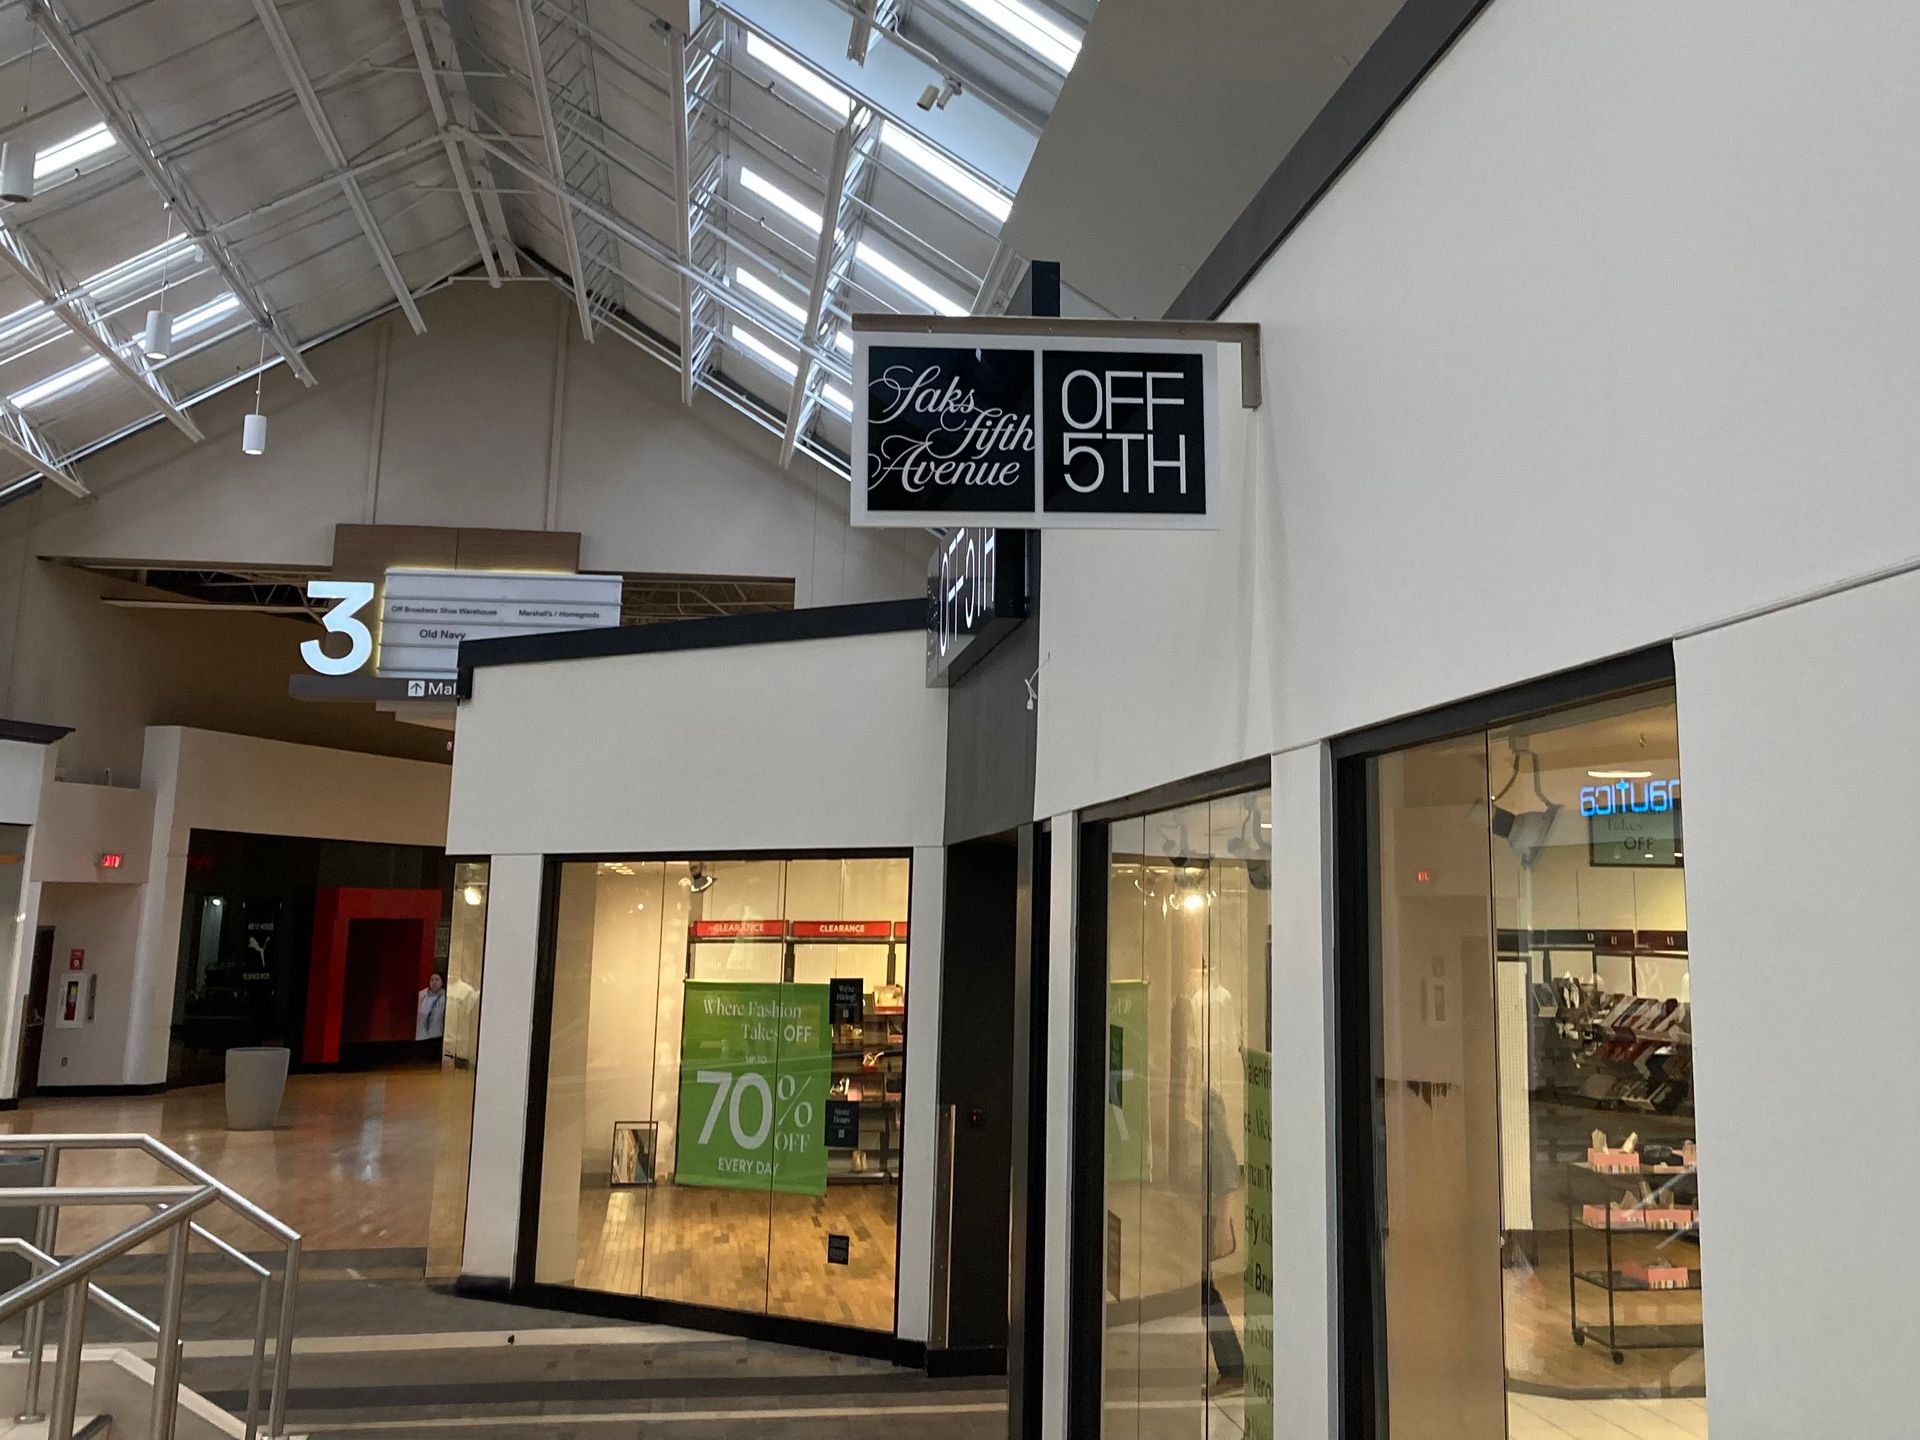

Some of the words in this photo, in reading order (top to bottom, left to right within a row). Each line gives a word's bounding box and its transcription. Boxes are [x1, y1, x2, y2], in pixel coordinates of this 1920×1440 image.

[868, 364, 977, 424] Saks
[1062, 369, 1185, 431] OFF
[926, 407, 1036, 460] Fifth
[868, 434, 1020, 493] Avenue
[1063, 432, 1187, 494] 5TH
[391, 605, 403, 613] Off
[404, 606, 438, 615] Broadway
[440, 607, 457, 615] Shoe
[459, 608, 498, 616] Warehouse
[558, 611, 600, 620] Homegoods
[300, 580, 375, 676] 3
[419, 629, 438, 639] Old
[440, 630, 466, 641] Navy
[713, 923, 765, 933] CLEARANCE
[819, 924, 865, 934] CLEARANCE
[703, 997, 745, 1017] Where
[748, 1000, 802, 1019] Fashion
[741, 1022, 779, 1041] Takes
[783, 1025, 812, 1043] OFF
[774, 1132, 811, 1153] OFF
[718, 1156, 752, 1175] EVERY
[756, 1159, 780, 1177] DAY
